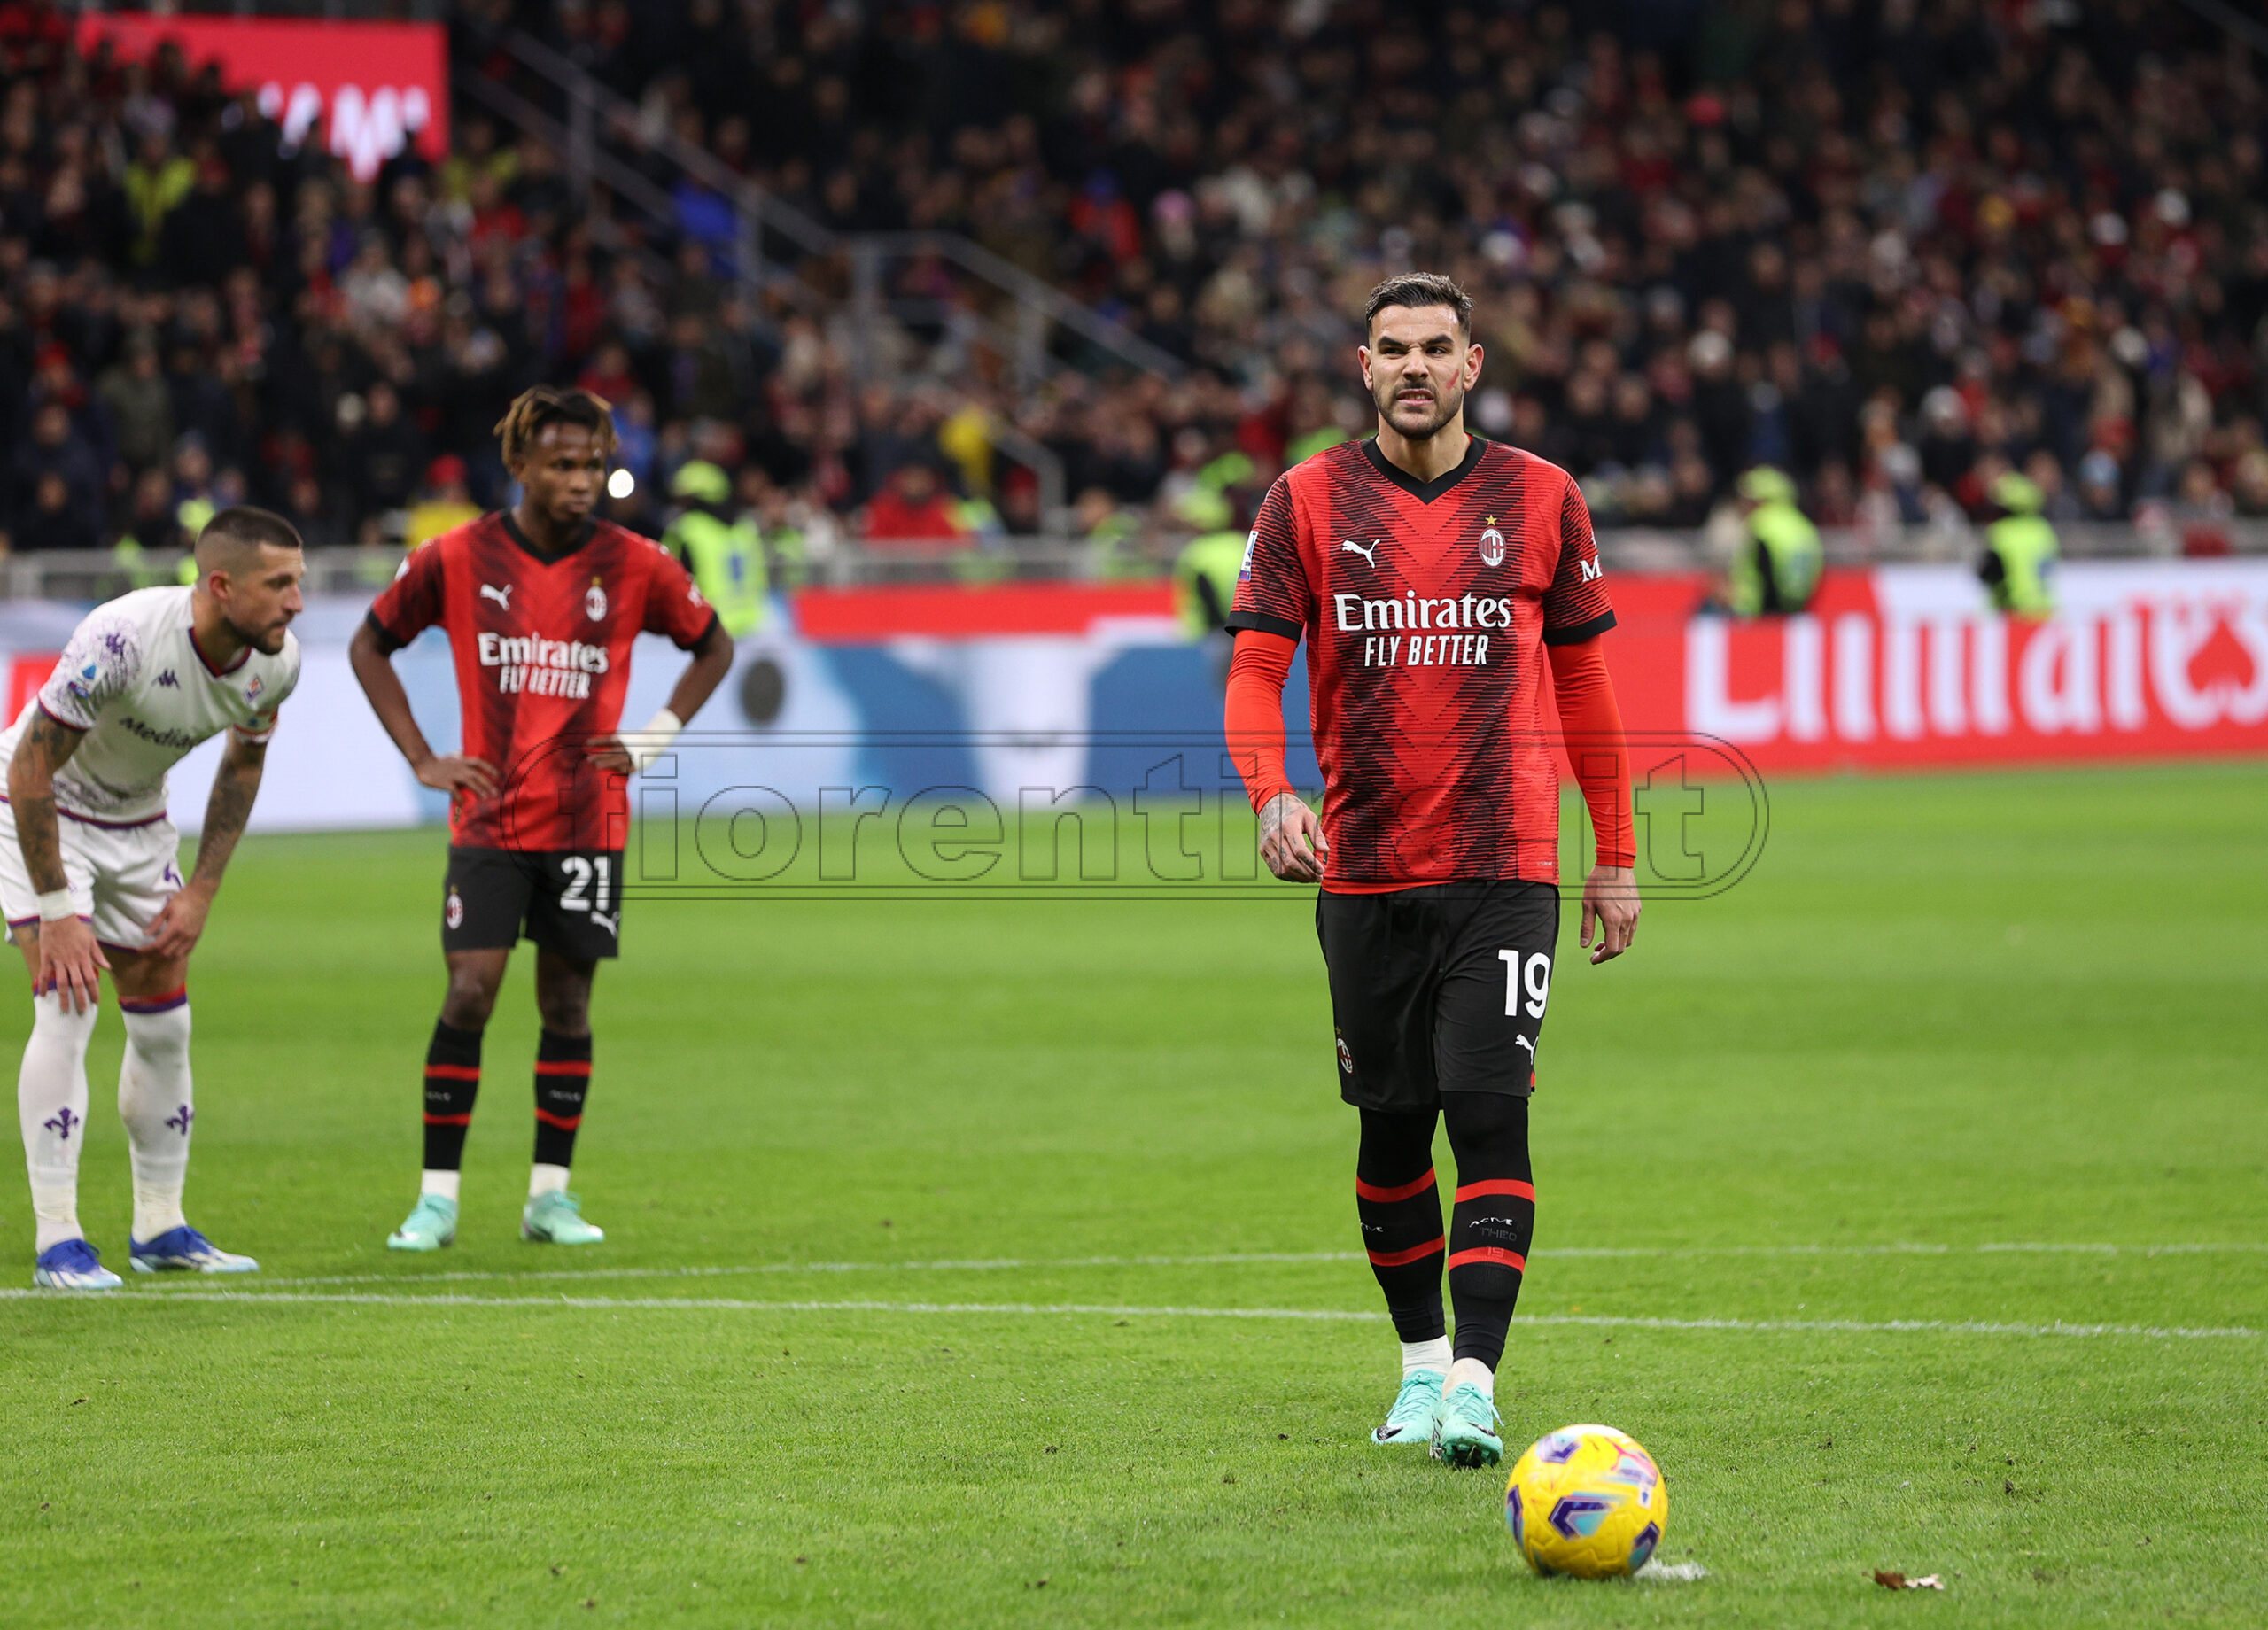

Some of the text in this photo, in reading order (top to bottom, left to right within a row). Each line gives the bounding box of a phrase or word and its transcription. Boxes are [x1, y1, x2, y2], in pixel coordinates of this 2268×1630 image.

[1333, 590, 1511, 631] Emirates
[478, 631, 610, 674] Emirates
[1364, 634, 1489, 667] FLY BETTER
[500, 665, 591, 699] FLY BETTER
[559, 856, 612, 912] 21
[1497, 949, 1551, 1020] 19
[1480, 1226, 1518, 1241] THEO
